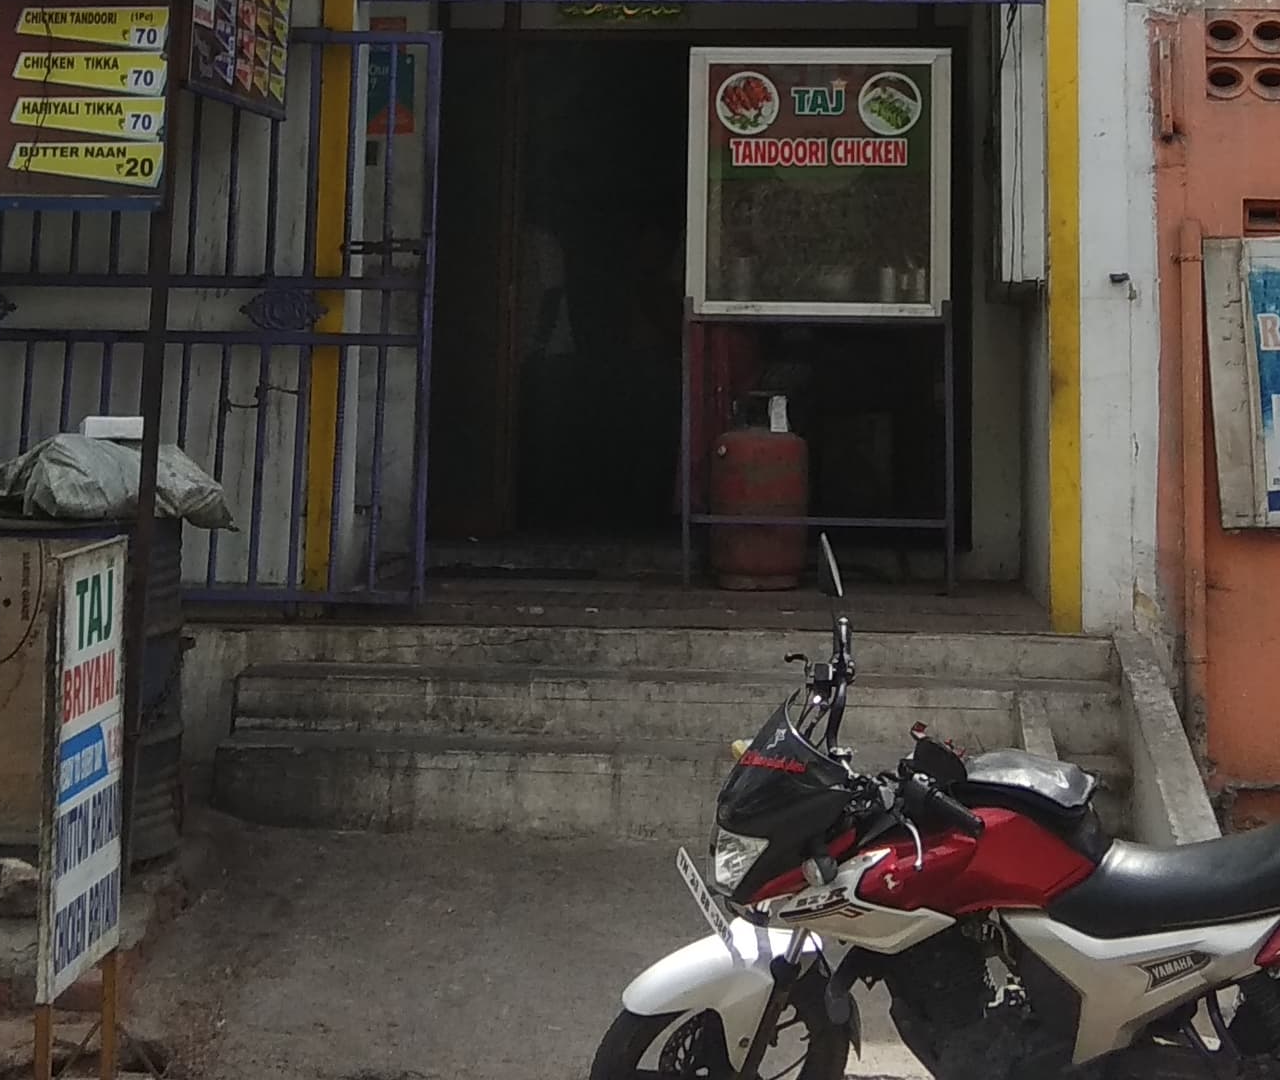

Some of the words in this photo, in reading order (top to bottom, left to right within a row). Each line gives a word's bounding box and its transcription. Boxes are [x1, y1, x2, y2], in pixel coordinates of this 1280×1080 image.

[24, 11, 67, 24] CHICKEN
[69, 11, 117, 25] TANDOORI
[23, 56, 75, 69] CHICKEN
[84, 56, 120, 70] TIKKA
[84, 102, 124, 116] TIKKA
[793, 87, 845, 114] TAJ
[18, 146, 79, 158] BUTTER
[84, 146, 127, 158] NAAN
[731, 139, 826, 166] TANDOORI
[832, 139, 908, 166] CHICKEN
[75, 568, 114, 651] TAJ
[63, 648, 116, 724] BRIYANI
[1151, 955, 1195, 980] YAMAHA
